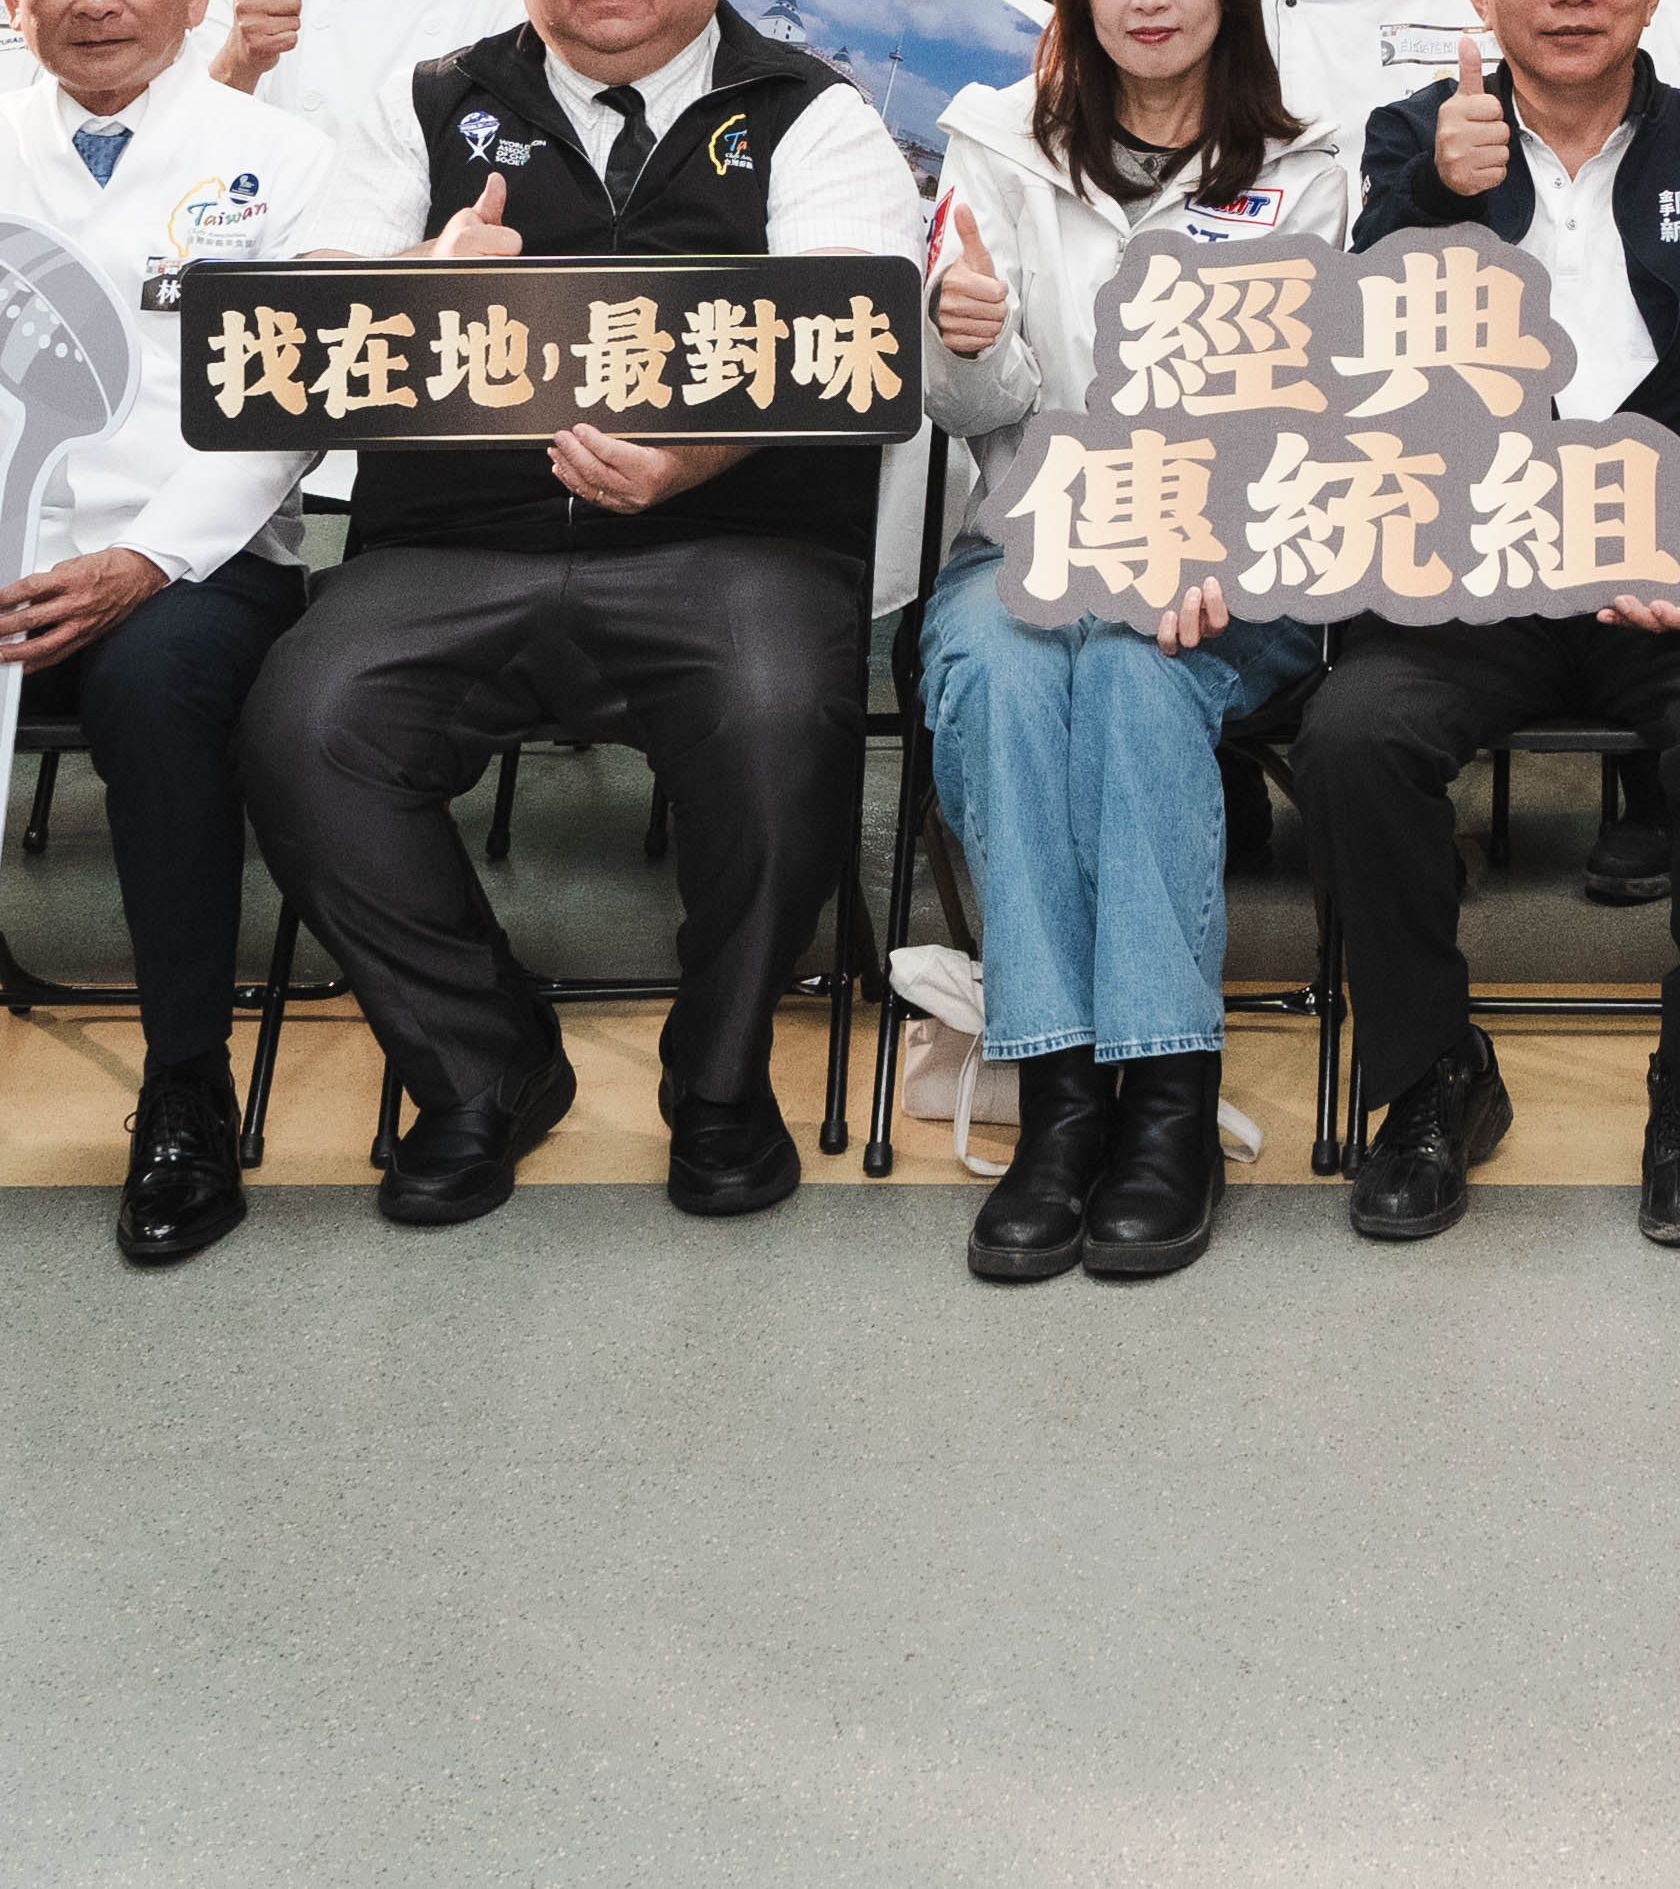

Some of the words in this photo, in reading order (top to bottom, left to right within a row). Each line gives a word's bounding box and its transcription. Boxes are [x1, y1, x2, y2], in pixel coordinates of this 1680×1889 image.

[186, 201, 269, 227] Taiwan
[205, 294, 903, 421] 找在地，最對味
[1112, 245, 1552, 419] 經典
